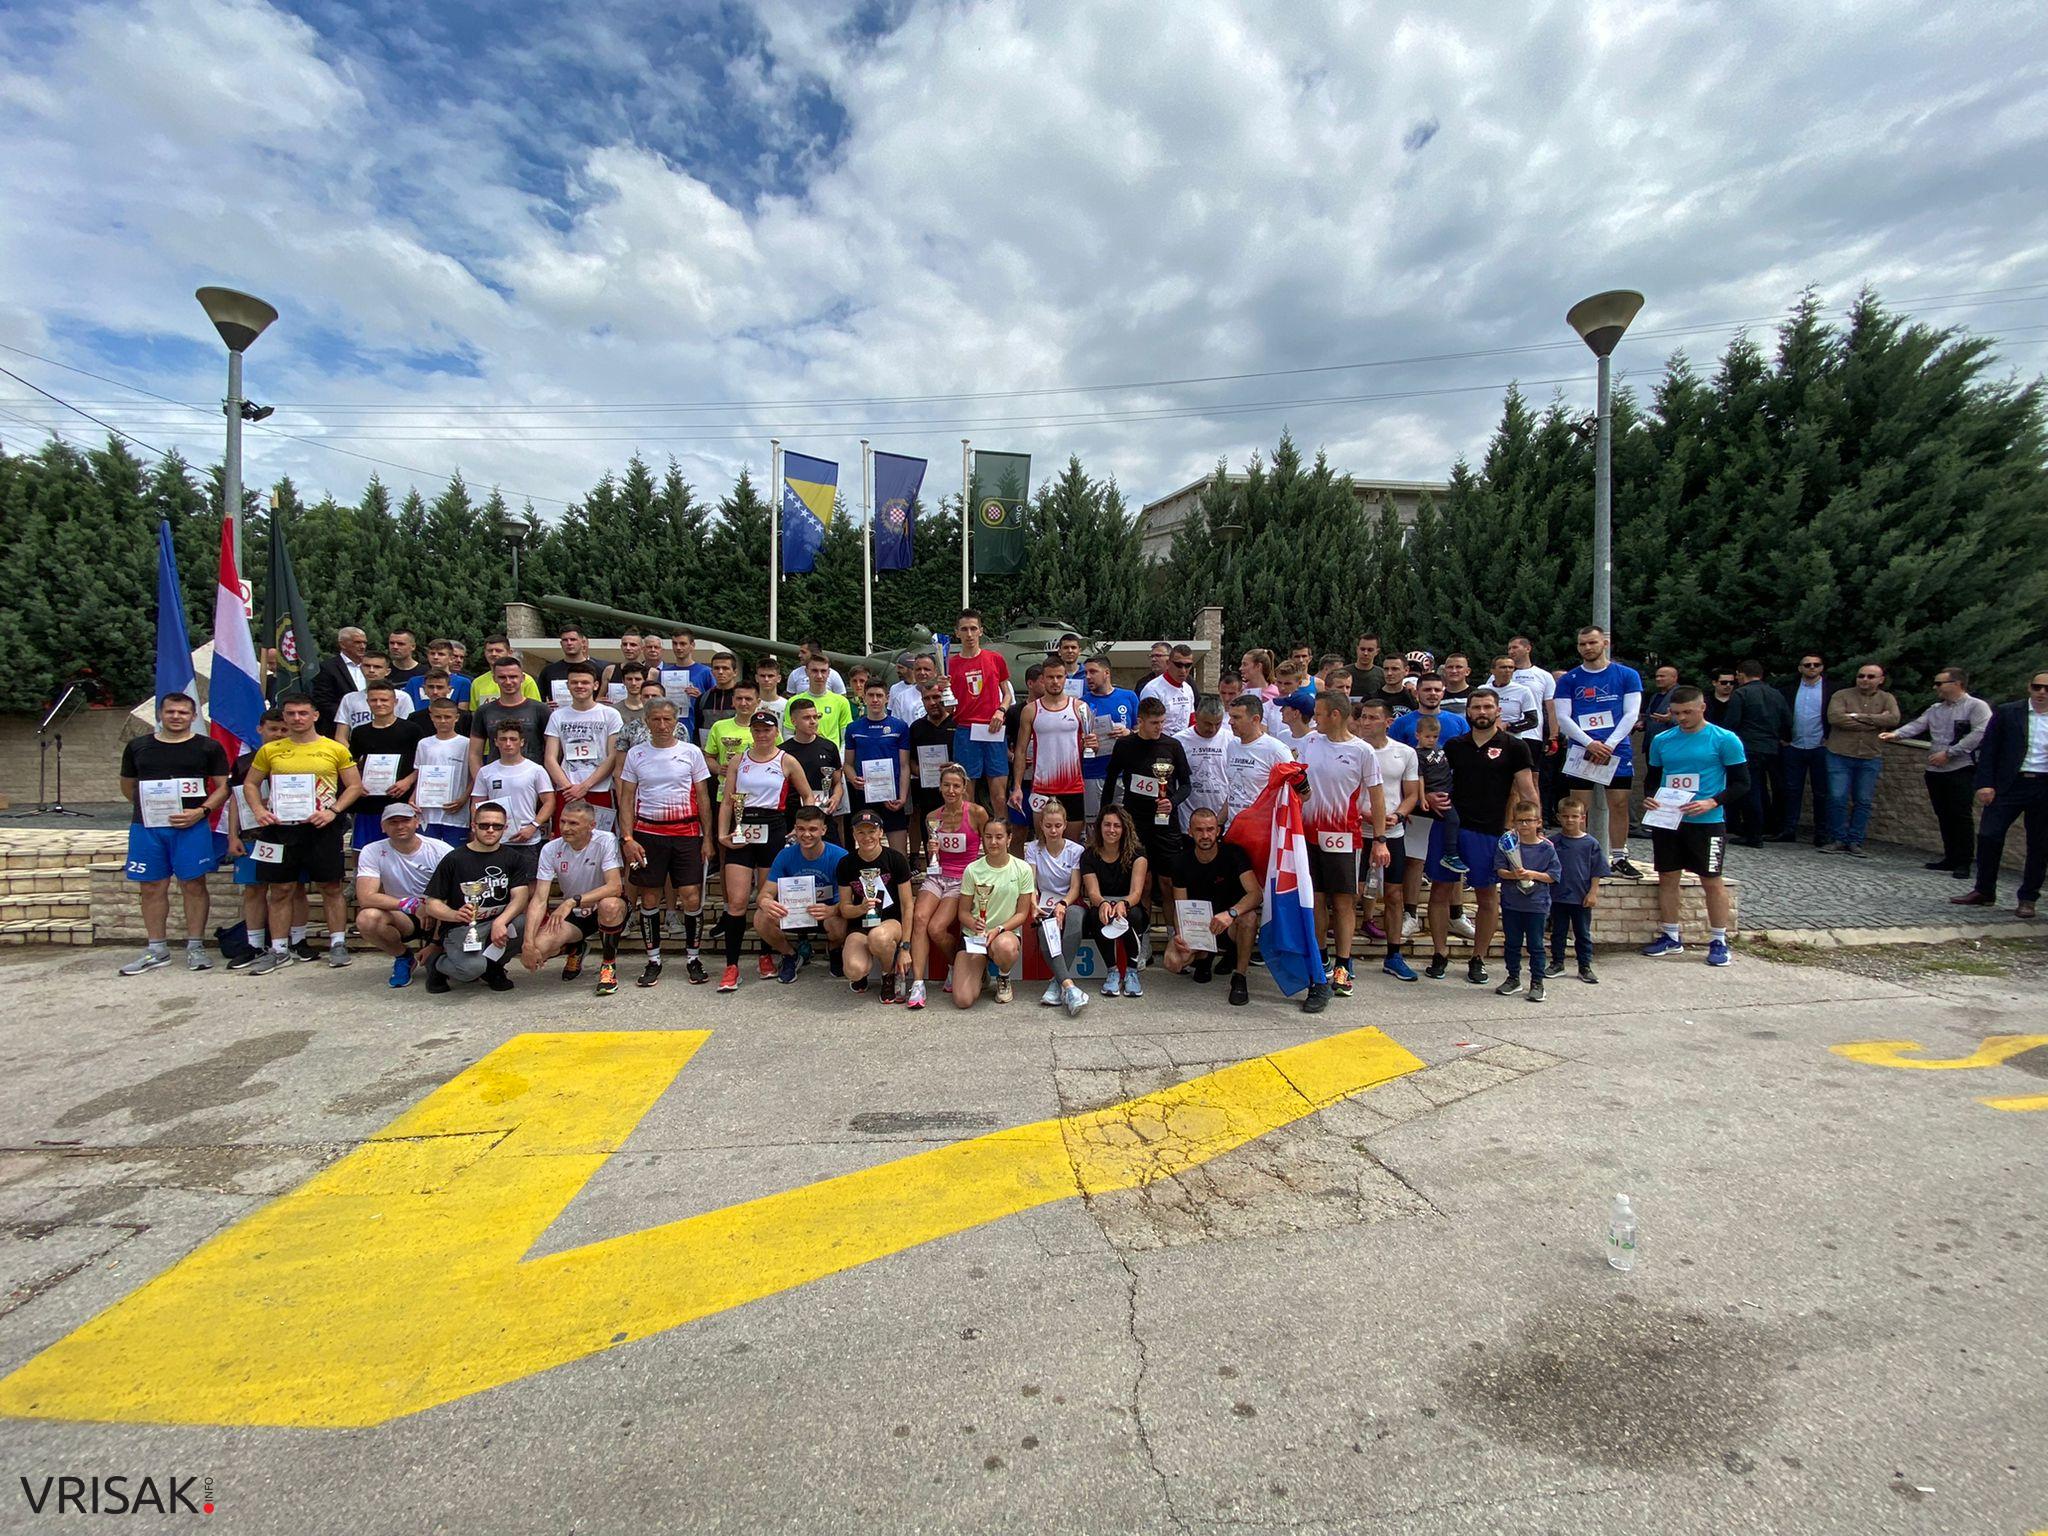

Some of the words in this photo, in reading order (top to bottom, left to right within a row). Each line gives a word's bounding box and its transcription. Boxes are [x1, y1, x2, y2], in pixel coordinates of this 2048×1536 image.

[1589, 715, 1604, 727] 81
[574, 745, 589, 756] 15
[181, 782, 198, 794] 33
[1136, 779, 1153, 792] 46
[1672, 777, 1692, 789] 80
[1032, 797, 1046, 809] 62
[744, 828, 761, 839] 65
[943, 836, 959, 849] 88
[1325, 836, 1344, 849] 66
[259, 845, 274, 859] 52
[127, 861, 147, 874] 25
[1076, 946, 1094, 976] 3
